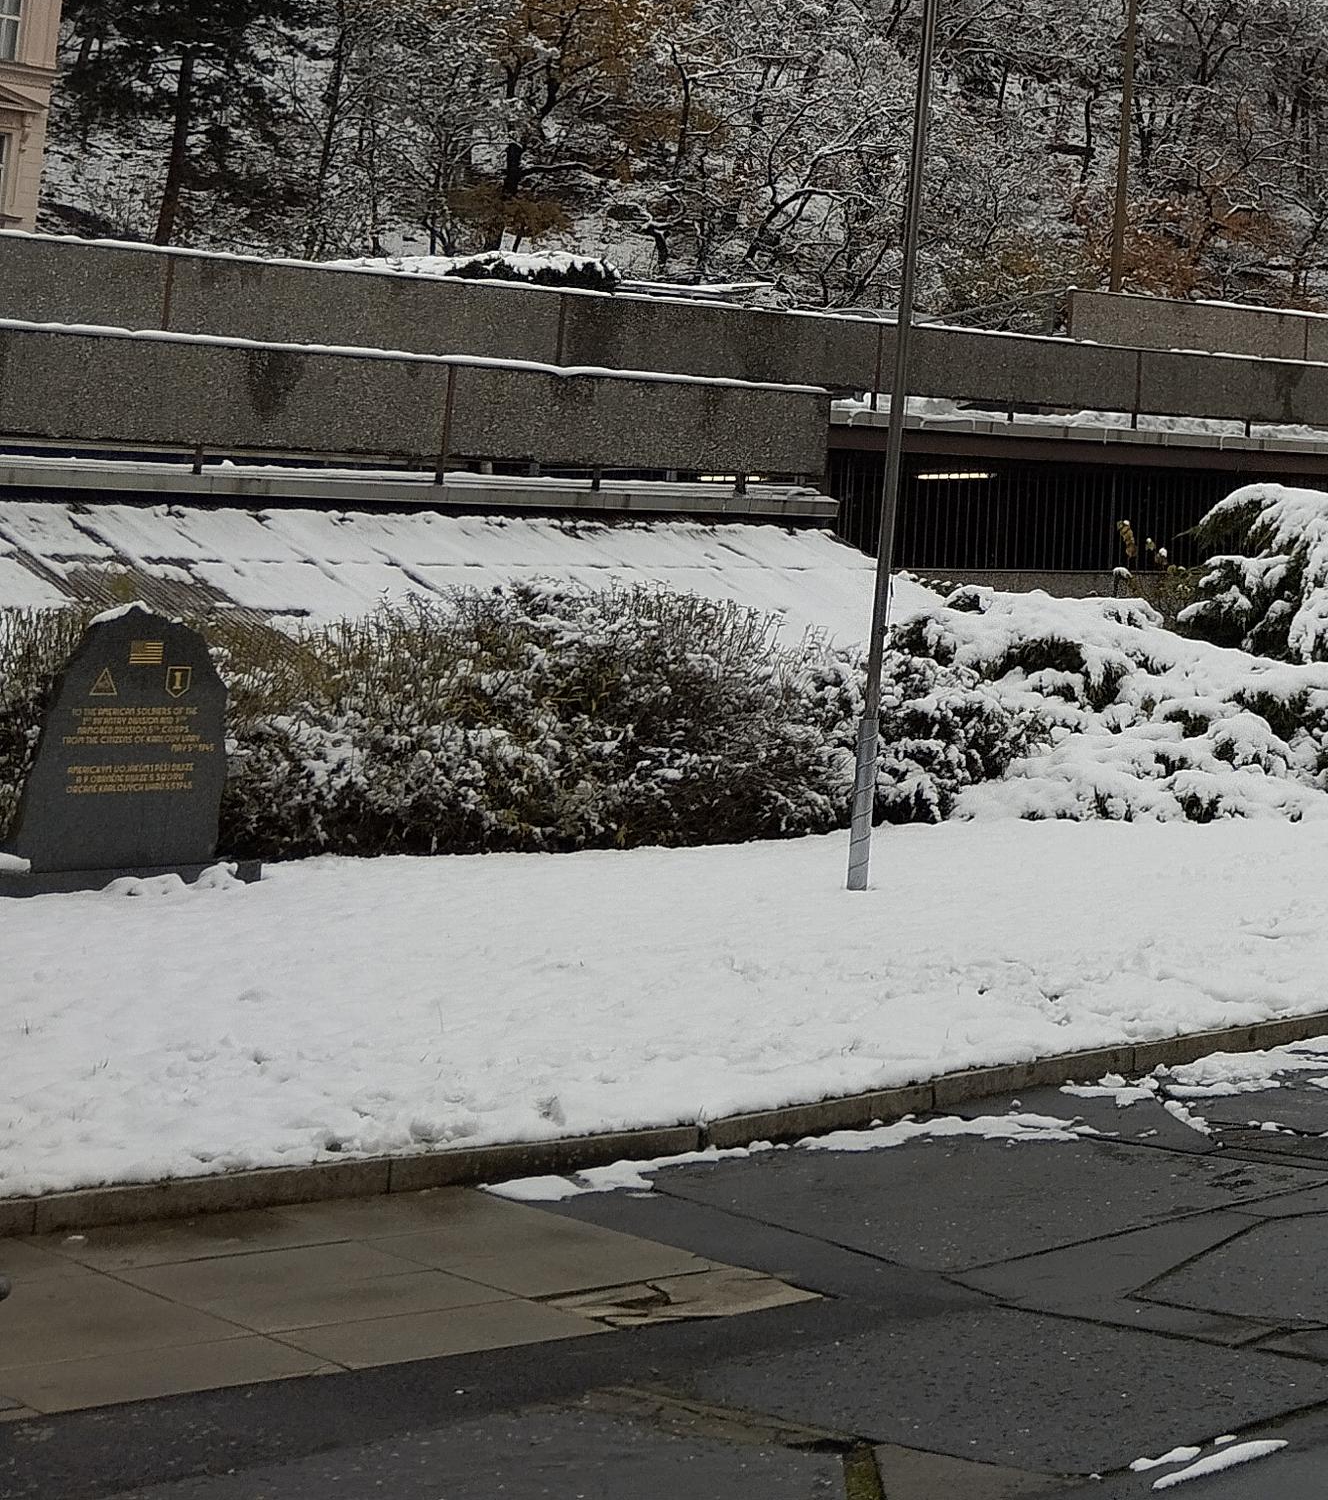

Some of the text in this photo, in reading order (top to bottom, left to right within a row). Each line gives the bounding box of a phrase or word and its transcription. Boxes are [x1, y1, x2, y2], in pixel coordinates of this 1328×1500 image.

[137, 707, 171, 715] SOLDIERS
[173, 707, 183, 715] OF
[162, 725, 189, 734] CORPS
[100, 736, 132, 744] CITIZENS
